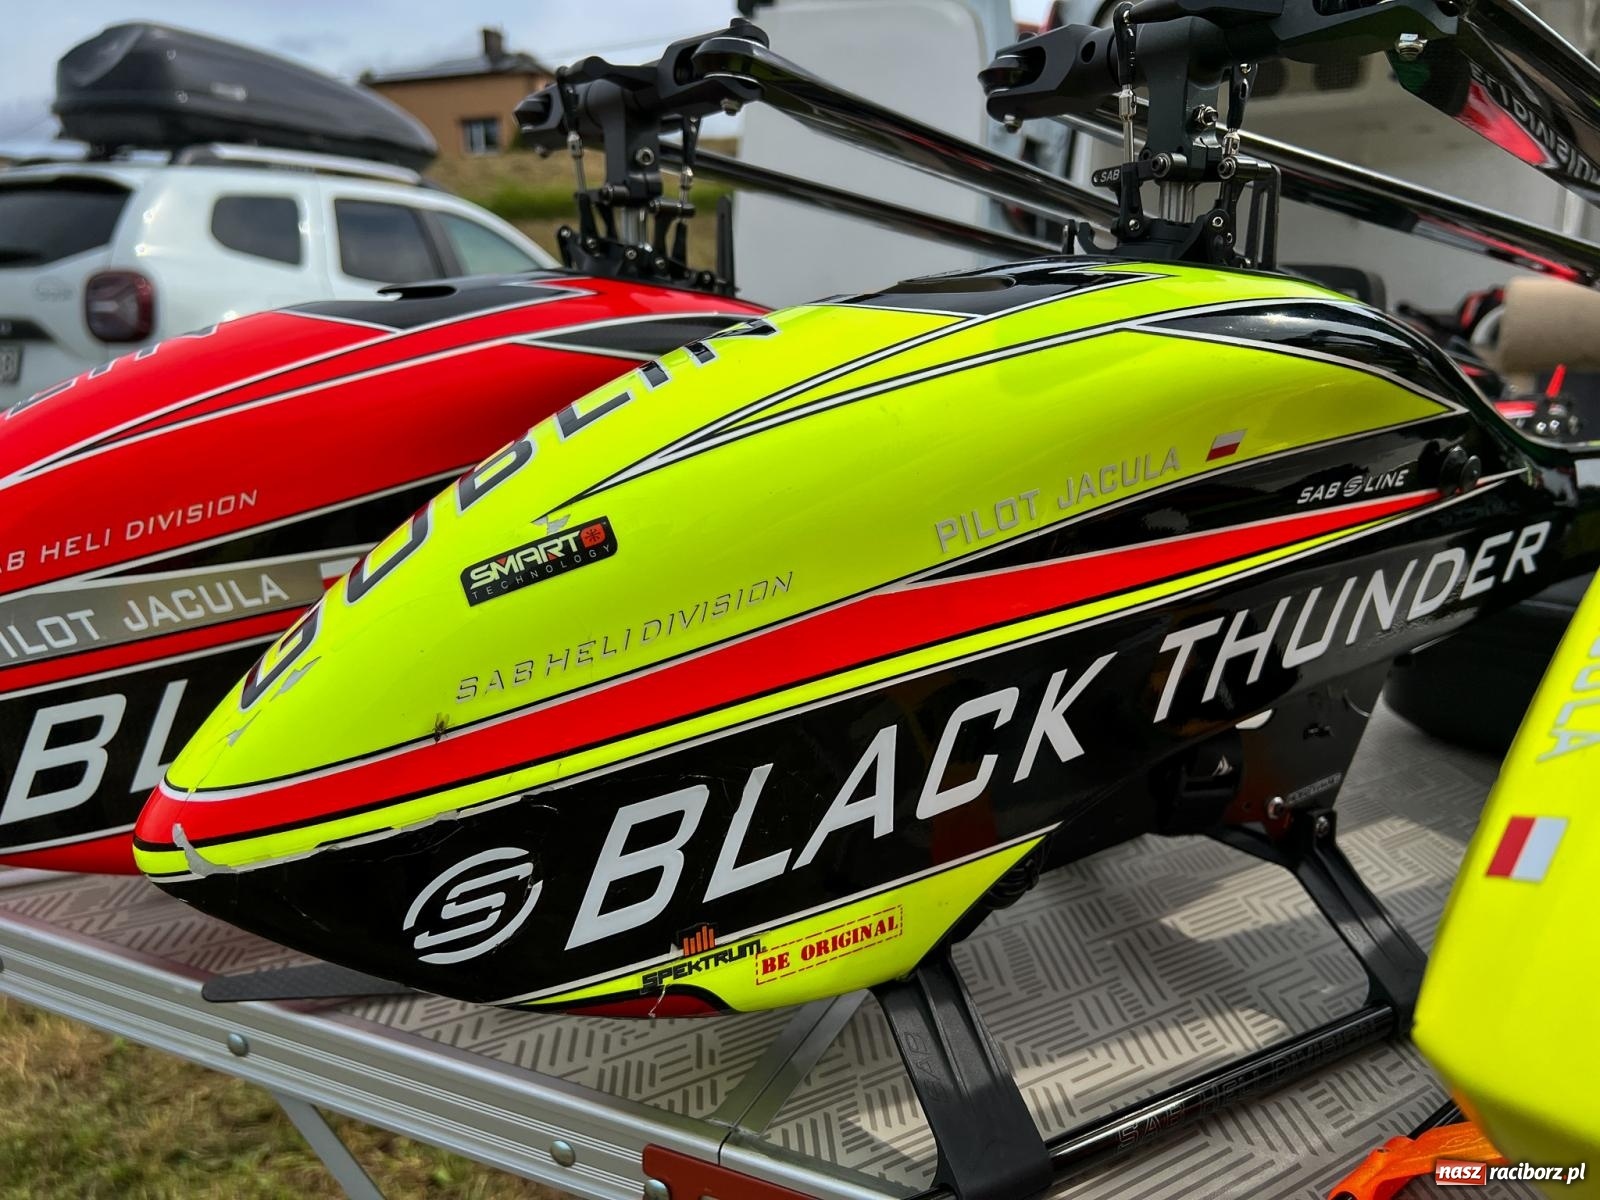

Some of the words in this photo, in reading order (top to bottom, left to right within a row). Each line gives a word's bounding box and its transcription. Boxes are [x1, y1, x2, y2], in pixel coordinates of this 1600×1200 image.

[1100, 169, 1120, 182] SAB
[935, 488, 1041, 553] PILOT
[1057, 447, 1181, 510] JACULA
[1297, 481, 1341, 504] SAB
[1364, 469, 1409, 492] LINE
[40, 528, 111, 564] HELI
[126, 489, 258, 541] DIVISION
[470, 530, 580, 590] SMART
[472, 544, 611, 600] TECHNOLOGY
[0, 609, 100, 658] ILOT
[123, 574, 290, 632] JACULA
[455, 660, 534, 704] SAB
[546, 629, 631, 677] HELI
[640, 571, 793, 645] DIVISION
[564, 651, 1118, 951] BLACK
[1153, 520, 1551, 724] THUNDER
[640, 939, 762, 995] SPEKTRUM
[762, 952, 791, 976] BE
[801, 915, 899, 961] ORIGINAL
